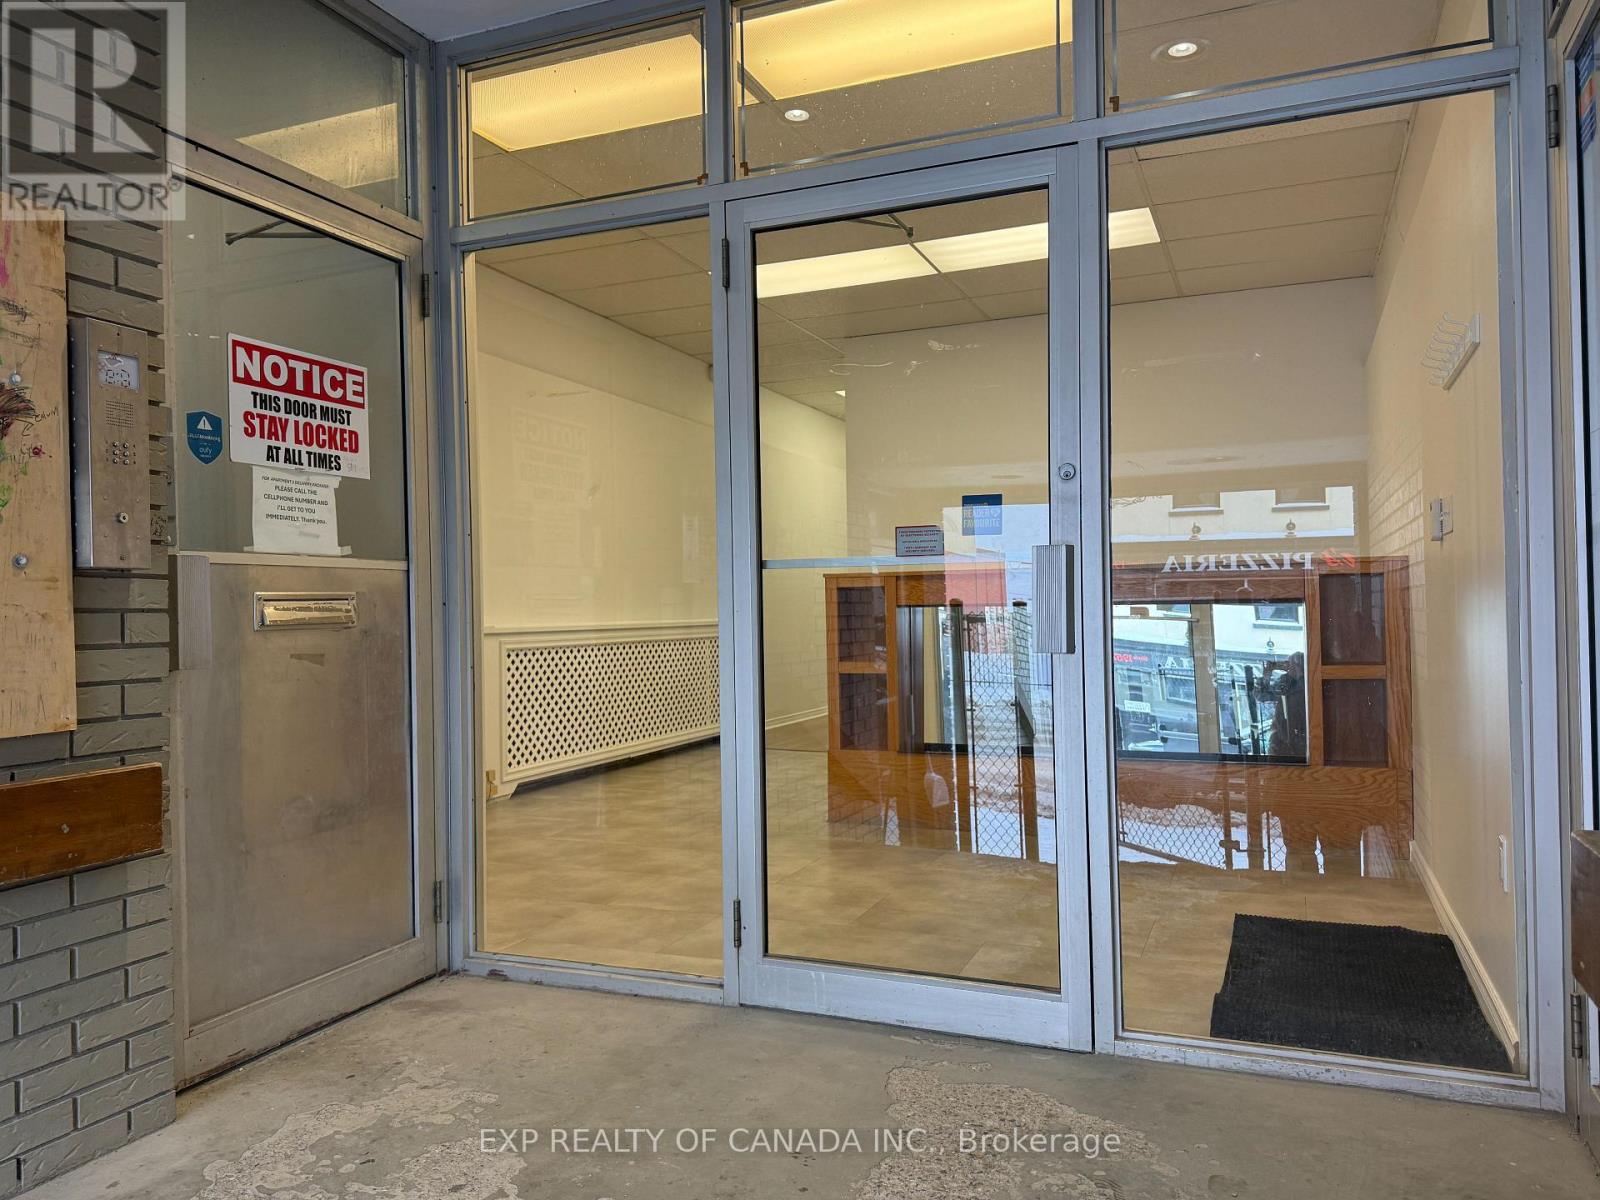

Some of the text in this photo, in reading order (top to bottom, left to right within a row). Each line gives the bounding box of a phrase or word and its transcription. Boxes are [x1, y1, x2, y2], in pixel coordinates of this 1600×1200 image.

[236, 346, 364, 403] NOTICE
[251, 391, 352, 426] THIS DOOR MUST
[243, 410, 359, 454] STAY LOCKED
[266, 445, 281, 463] AT
[284, 447, 304, 466] ALL
[305, 451, 341, 471] TIMES
[263, 493, 294, 502] CELLPHONE
[294, 497, 316, 505] NUMBER
[274, 485, 293, 493] PLEASE
[963, 518, 1000, 529] FAVOURITE
